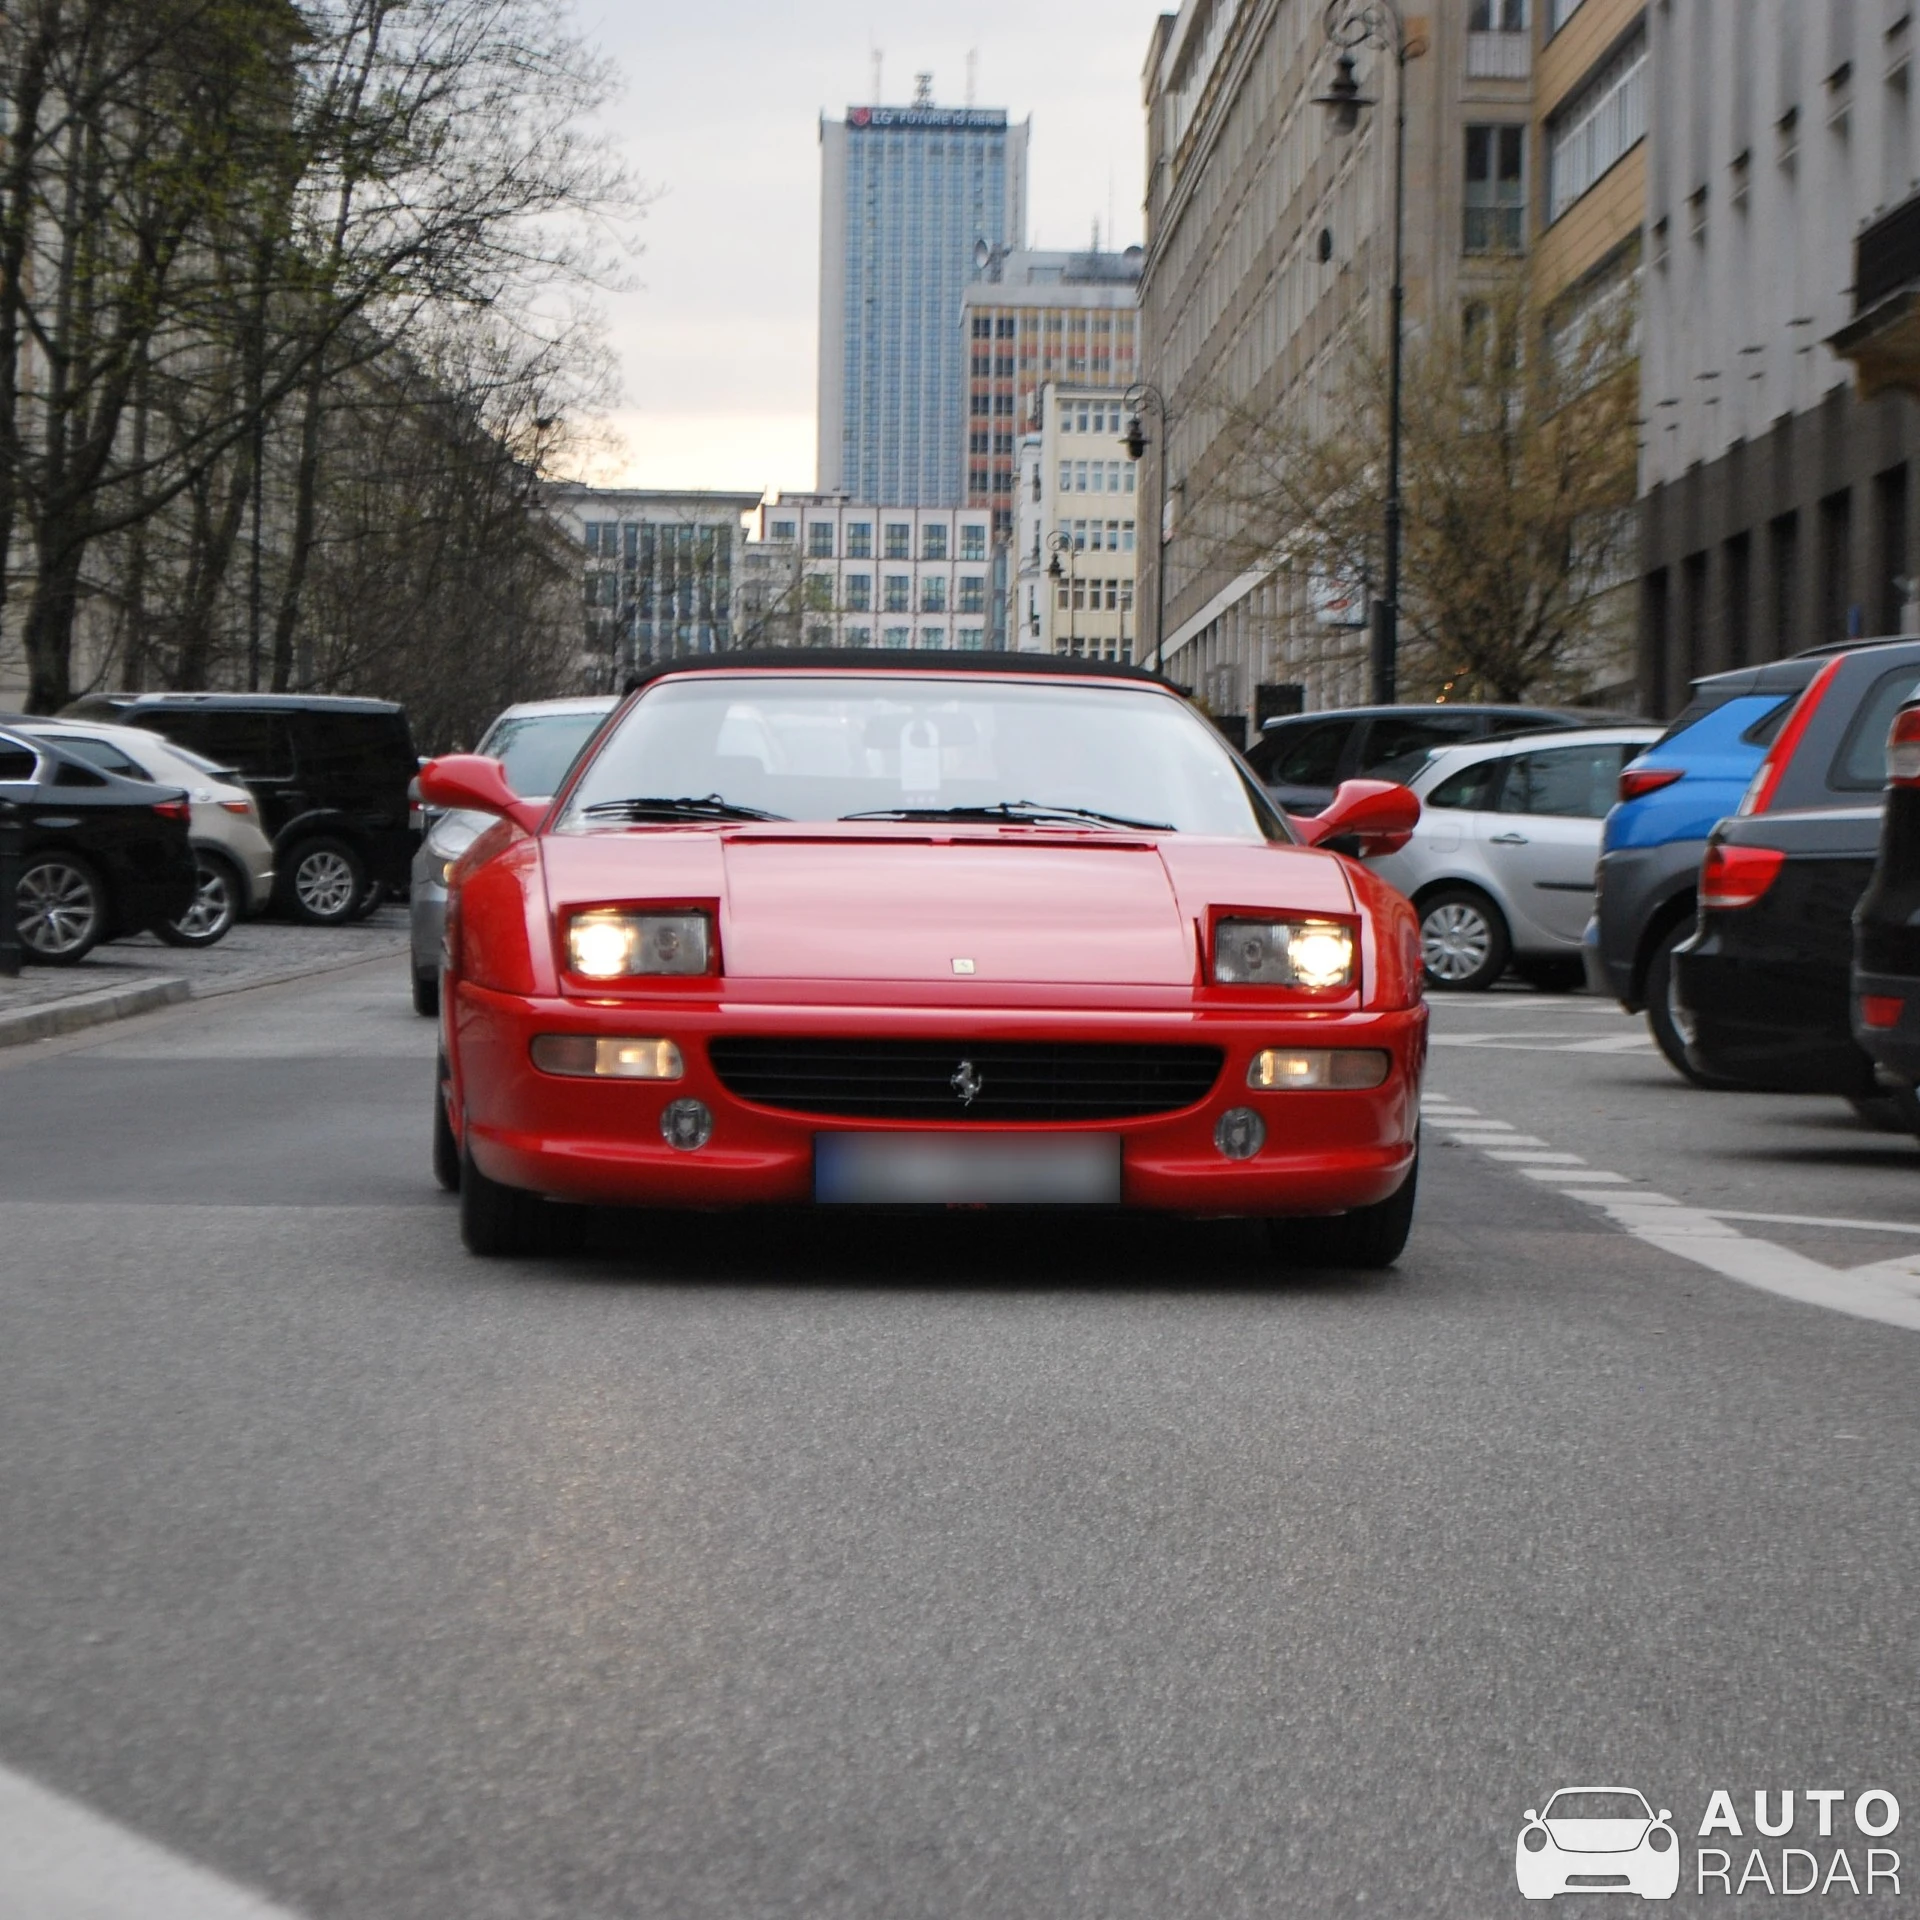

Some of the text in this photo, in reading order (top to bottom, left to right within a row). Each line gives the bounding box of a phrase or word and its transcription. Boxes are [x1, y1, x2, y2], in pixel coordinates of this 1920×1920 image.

[872, 111, 892, 124] LG
[899, 112, 949, 125] FUTURE
[952, 112, 965, 125] IS
